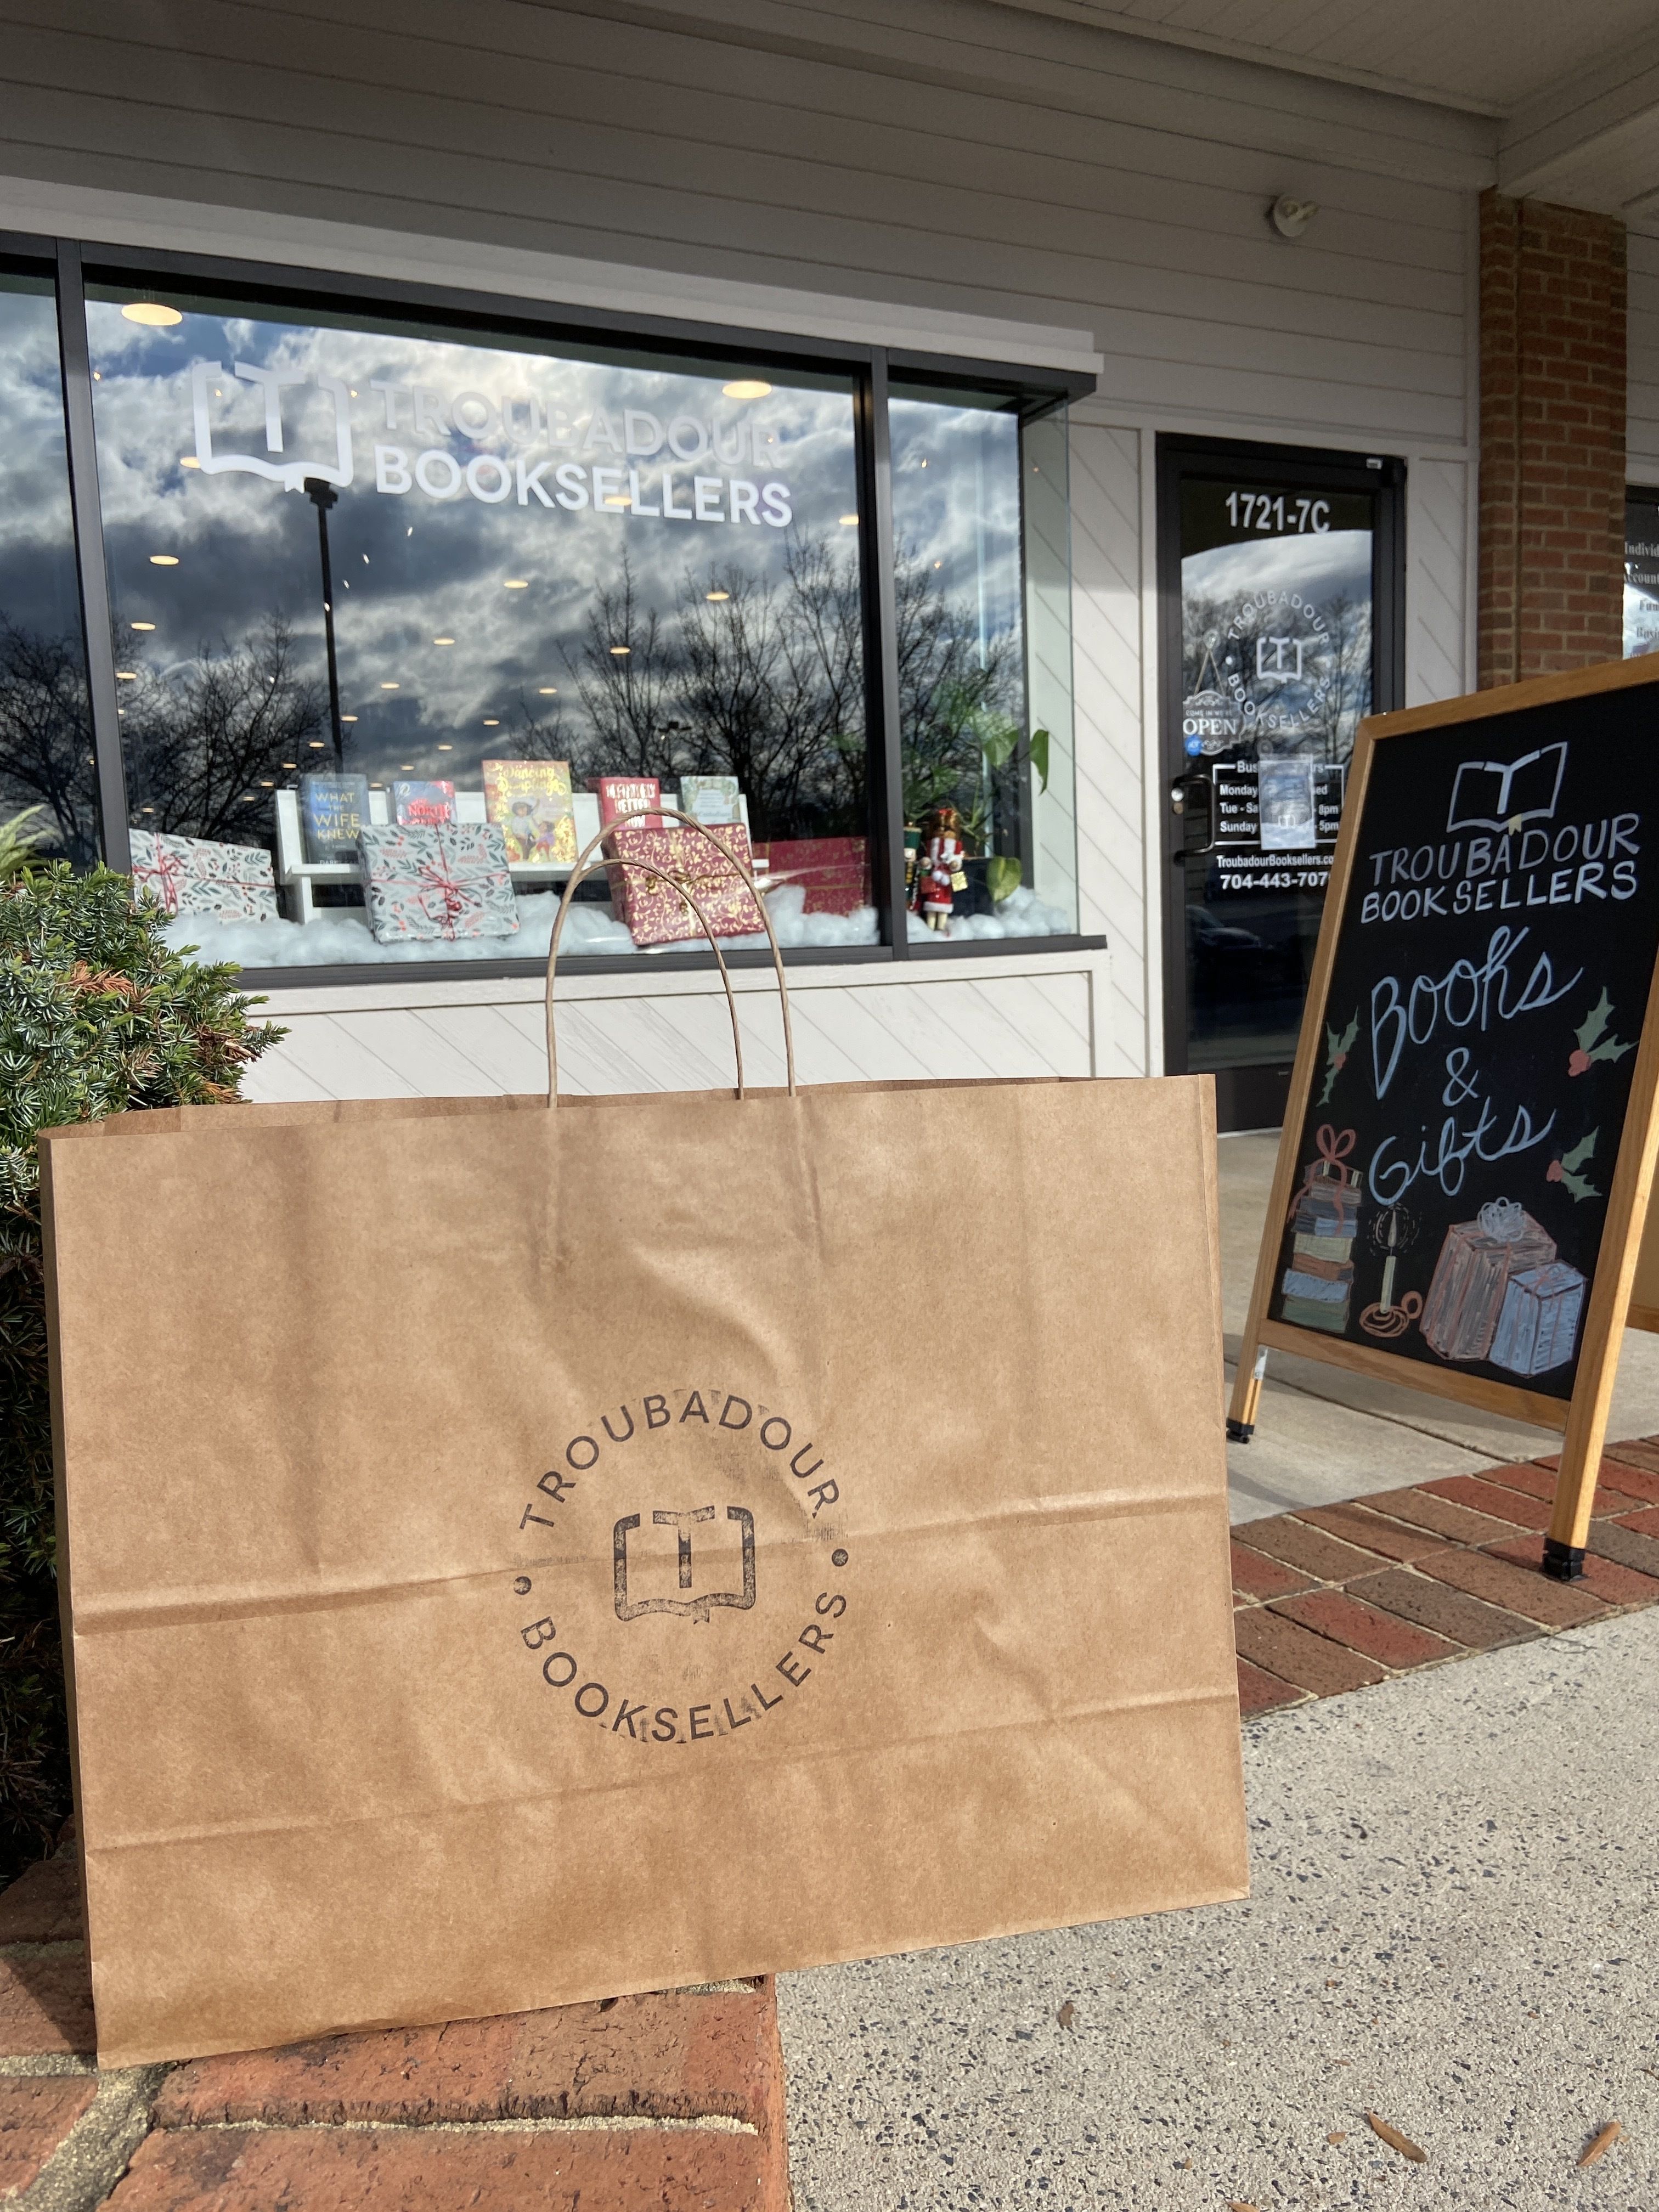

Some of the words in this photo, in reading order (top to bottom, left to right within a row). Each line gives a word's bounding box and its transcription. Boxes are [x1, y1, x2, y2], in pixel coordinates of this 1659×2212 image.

[370, 377, 781, 469] TROUBADOUR
[374, 445, 793, 527] BOOKSELLERS
[1226, 491, 1330, 533] 1721-7C
[1228, 590, 1329, 645] TROUBADOUR
[1183, 718, 1237, 735] OPEN
[315, 792, 356, 803] WHAT
[1220, 783, 1259, 798] Monday
[313, 813, 360, 827] WIFE
[1220, 802, 1238, 814] Tue
[1246, 802, 1259, 814] Sa
[1318, 804, 1339, 816] 8pm
[318, 828, 360, 840] KNEW
[1220, 820, 1257, 834] Sunday
[1319, 820, 1339, 833] 5pm
[1216, 853, 1334, 868] TroubadourBooksellers.co
[1369, 813, 1640, 886] TROUBADOUR
[1220, 871, 1331, 890] 704-443-707
[1361, 860, 1637, 924] BOOKSELLERS
[1372, 925, 1584, 1100] Books
[1442, 1047, 1479, 1108] &
[1368, 1096, 1557, 1206] Gifts
[519, 1390, 840, 1530] TROUBADOUR
[520, 1592, 847, 1742] BOOKSELLERS
